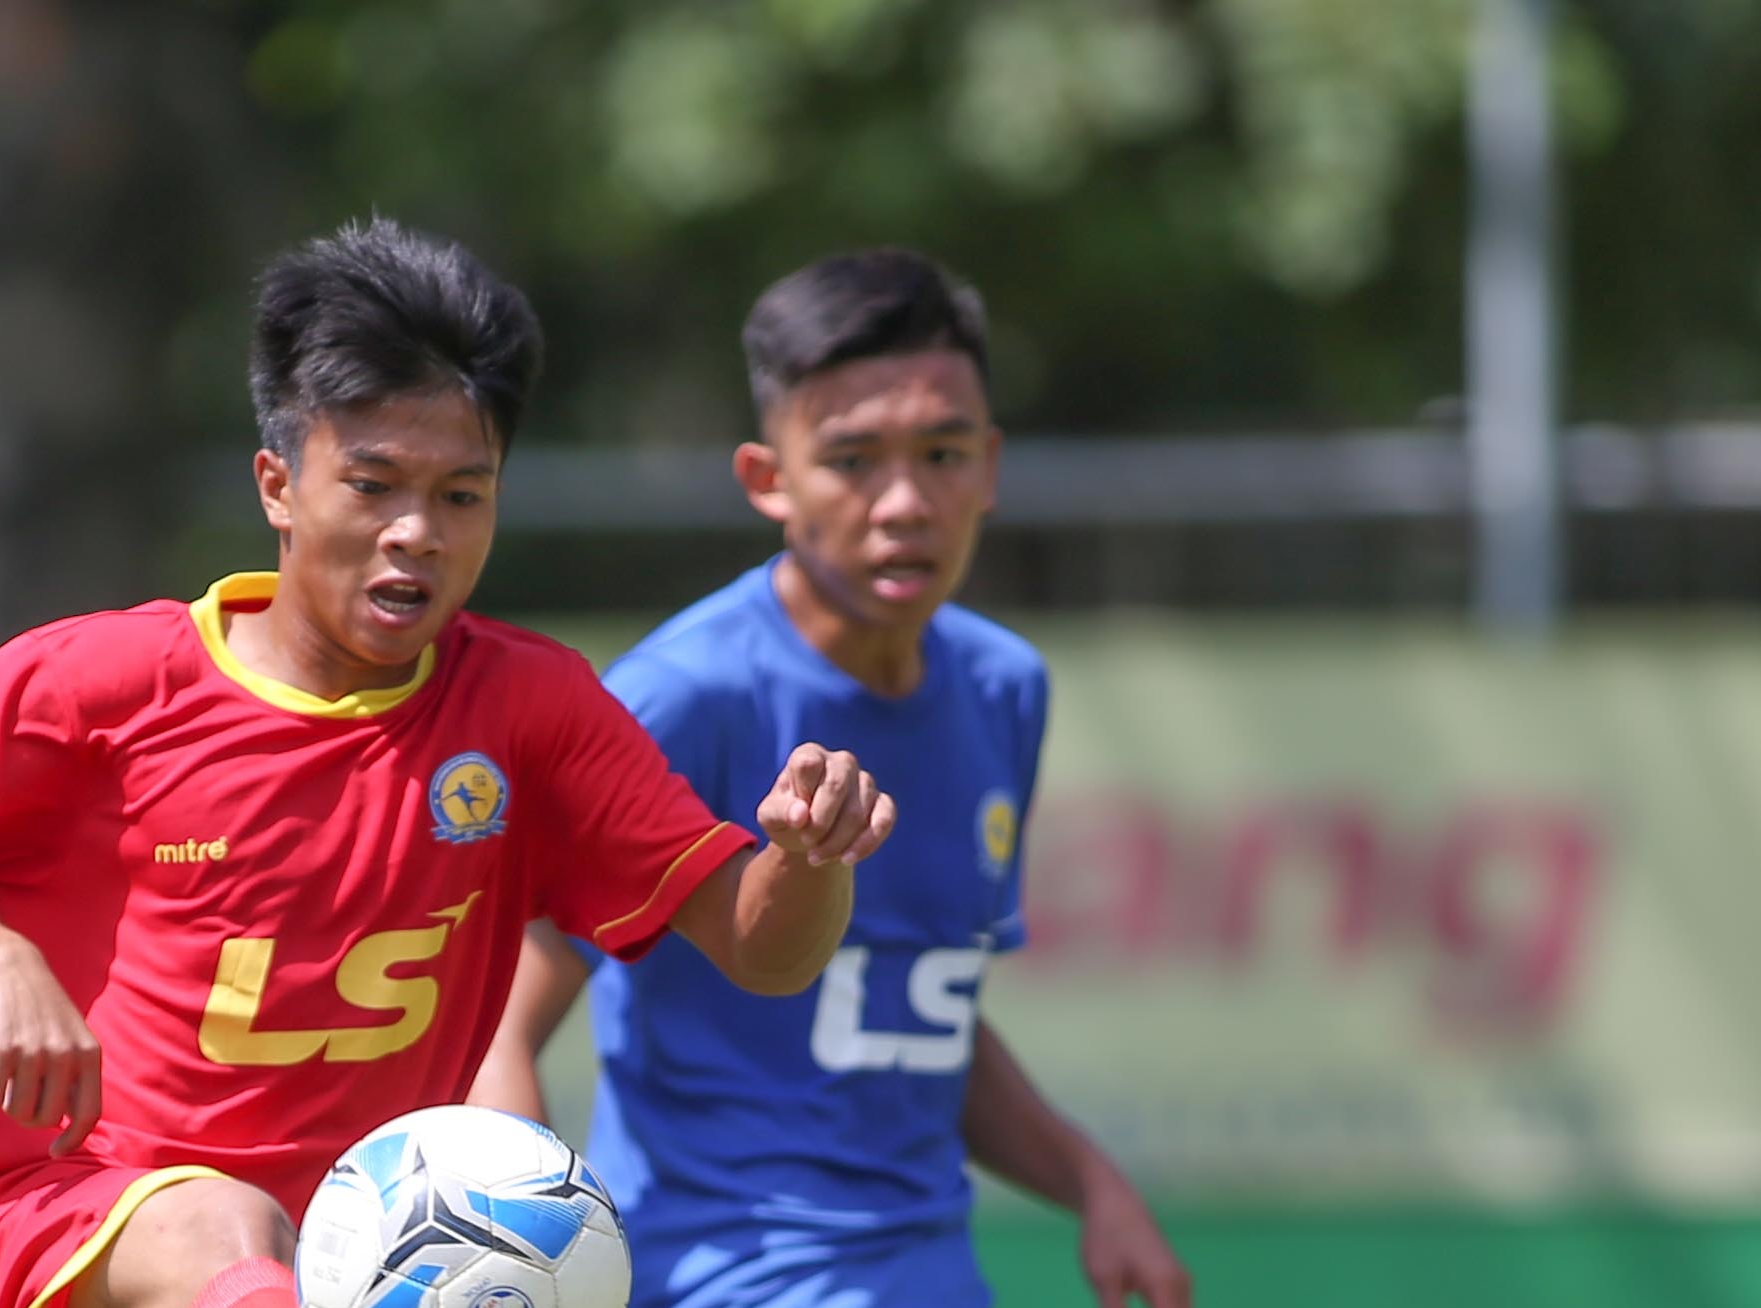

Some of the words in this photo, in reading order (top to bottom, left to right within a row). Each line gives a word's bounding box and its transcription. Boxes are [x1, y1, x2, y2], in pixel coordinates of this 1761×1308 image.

[154, 838, 228, 863] mitre
[197, 920, 449, 1066] LS
[809, 942, 989, 1075] LS
